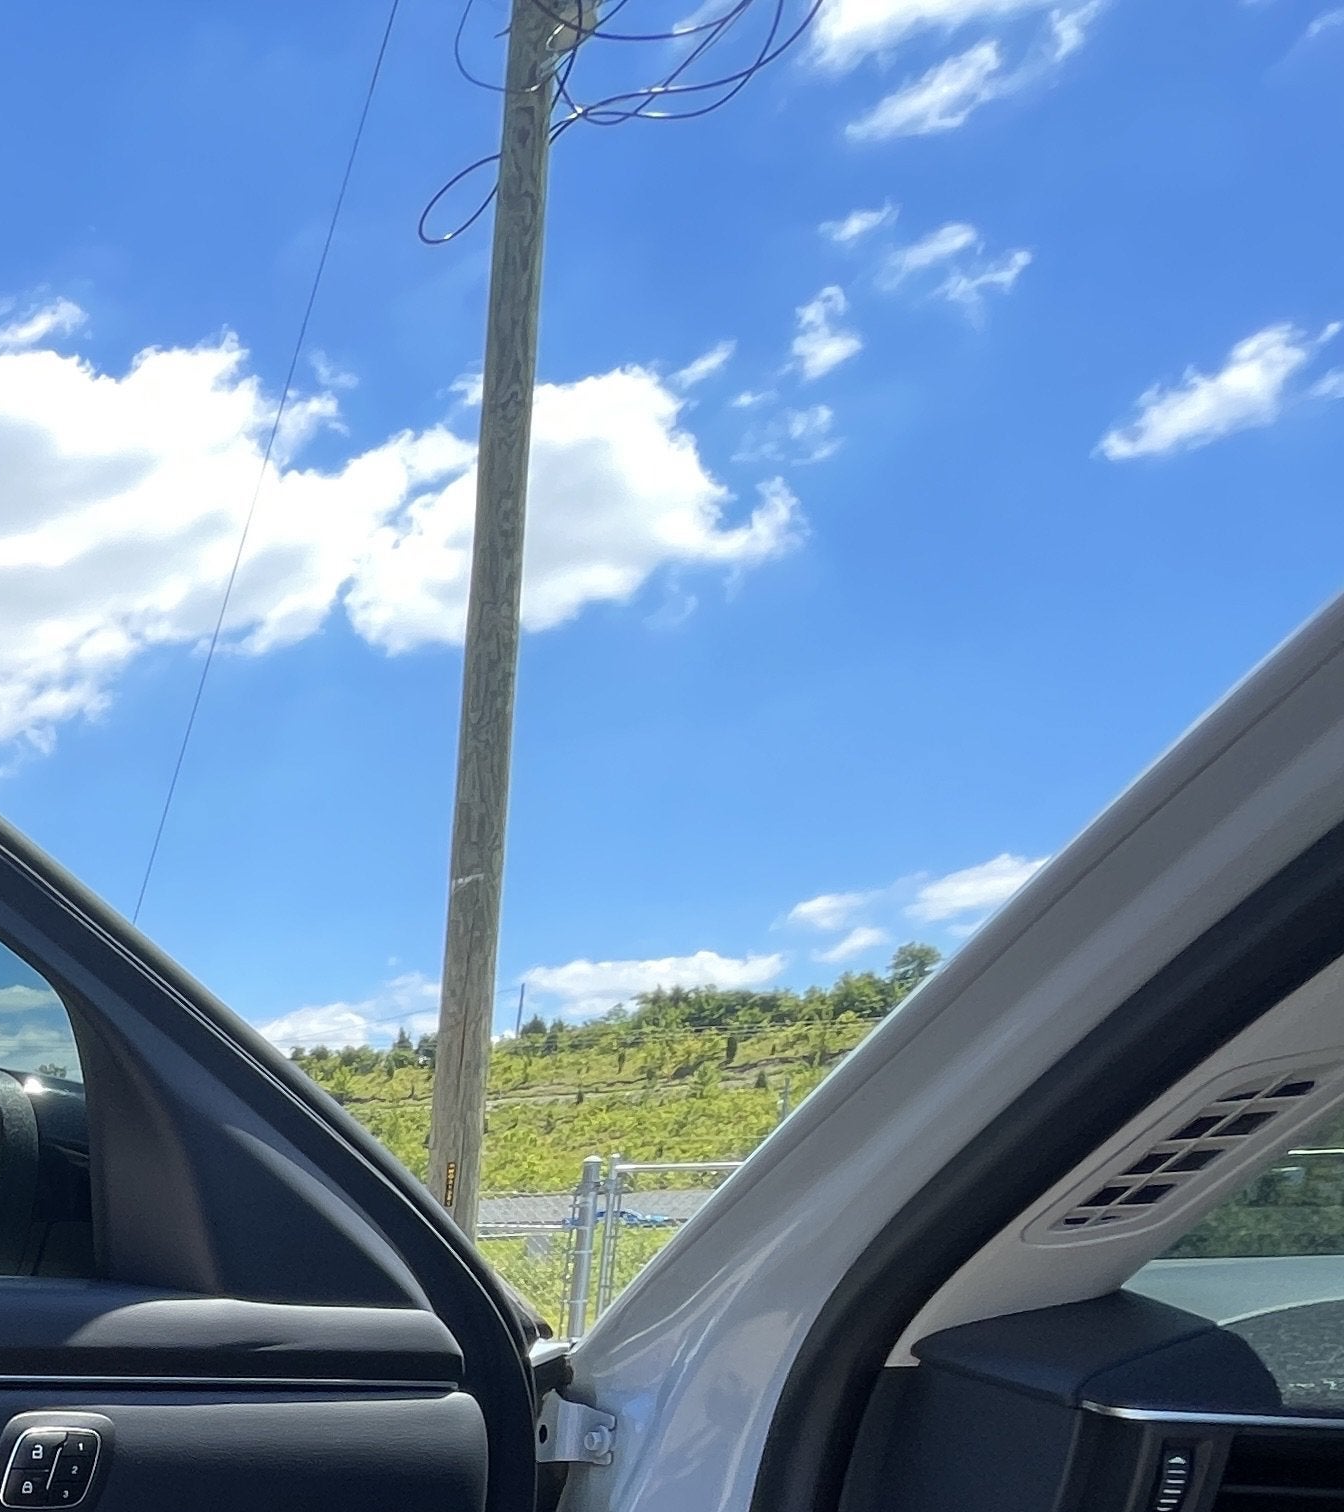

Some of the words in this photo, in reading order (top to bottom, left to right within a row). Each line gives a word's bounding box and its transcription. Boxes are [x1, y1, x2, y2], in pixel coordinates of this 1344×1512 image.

[78, 1442, 84, 1451] 1
[71, 1465, 78, 1474] 2
[63, 1490, 69, 1498] 3
